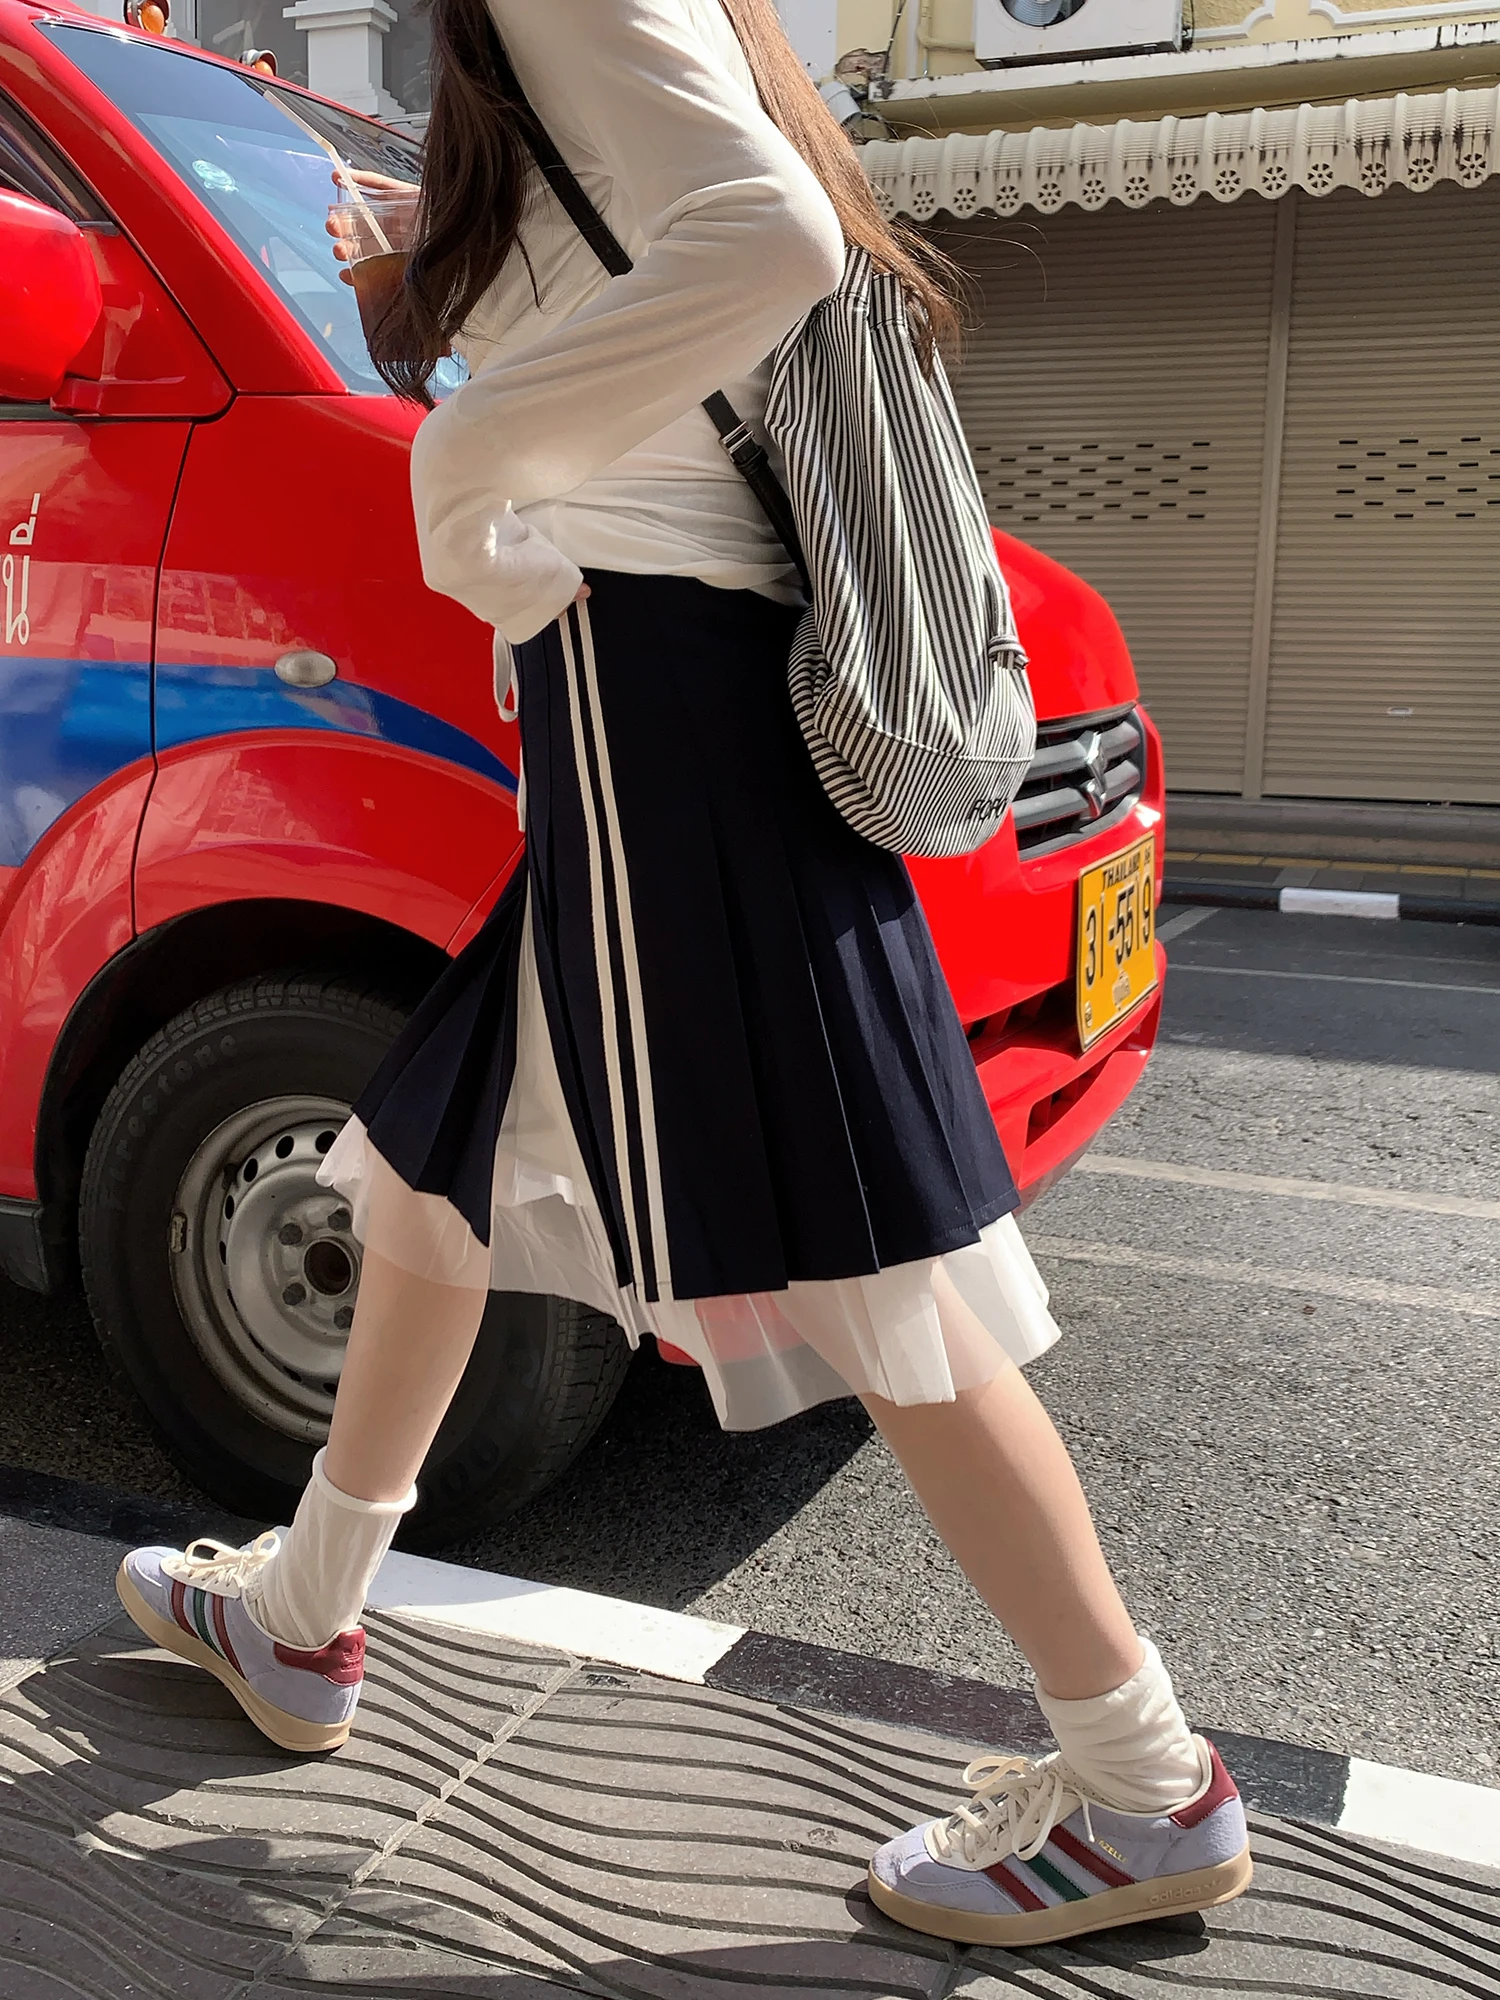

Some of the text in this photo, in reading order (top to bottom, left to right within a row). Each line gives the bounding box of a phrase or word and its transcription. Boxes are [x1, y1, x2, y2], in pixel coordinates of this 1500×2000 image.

[0, 493, 41, 646] นี่
[1101, 850, 1141, 892] THAILAND
[1149, 1885, 1202, 1905] adidas
